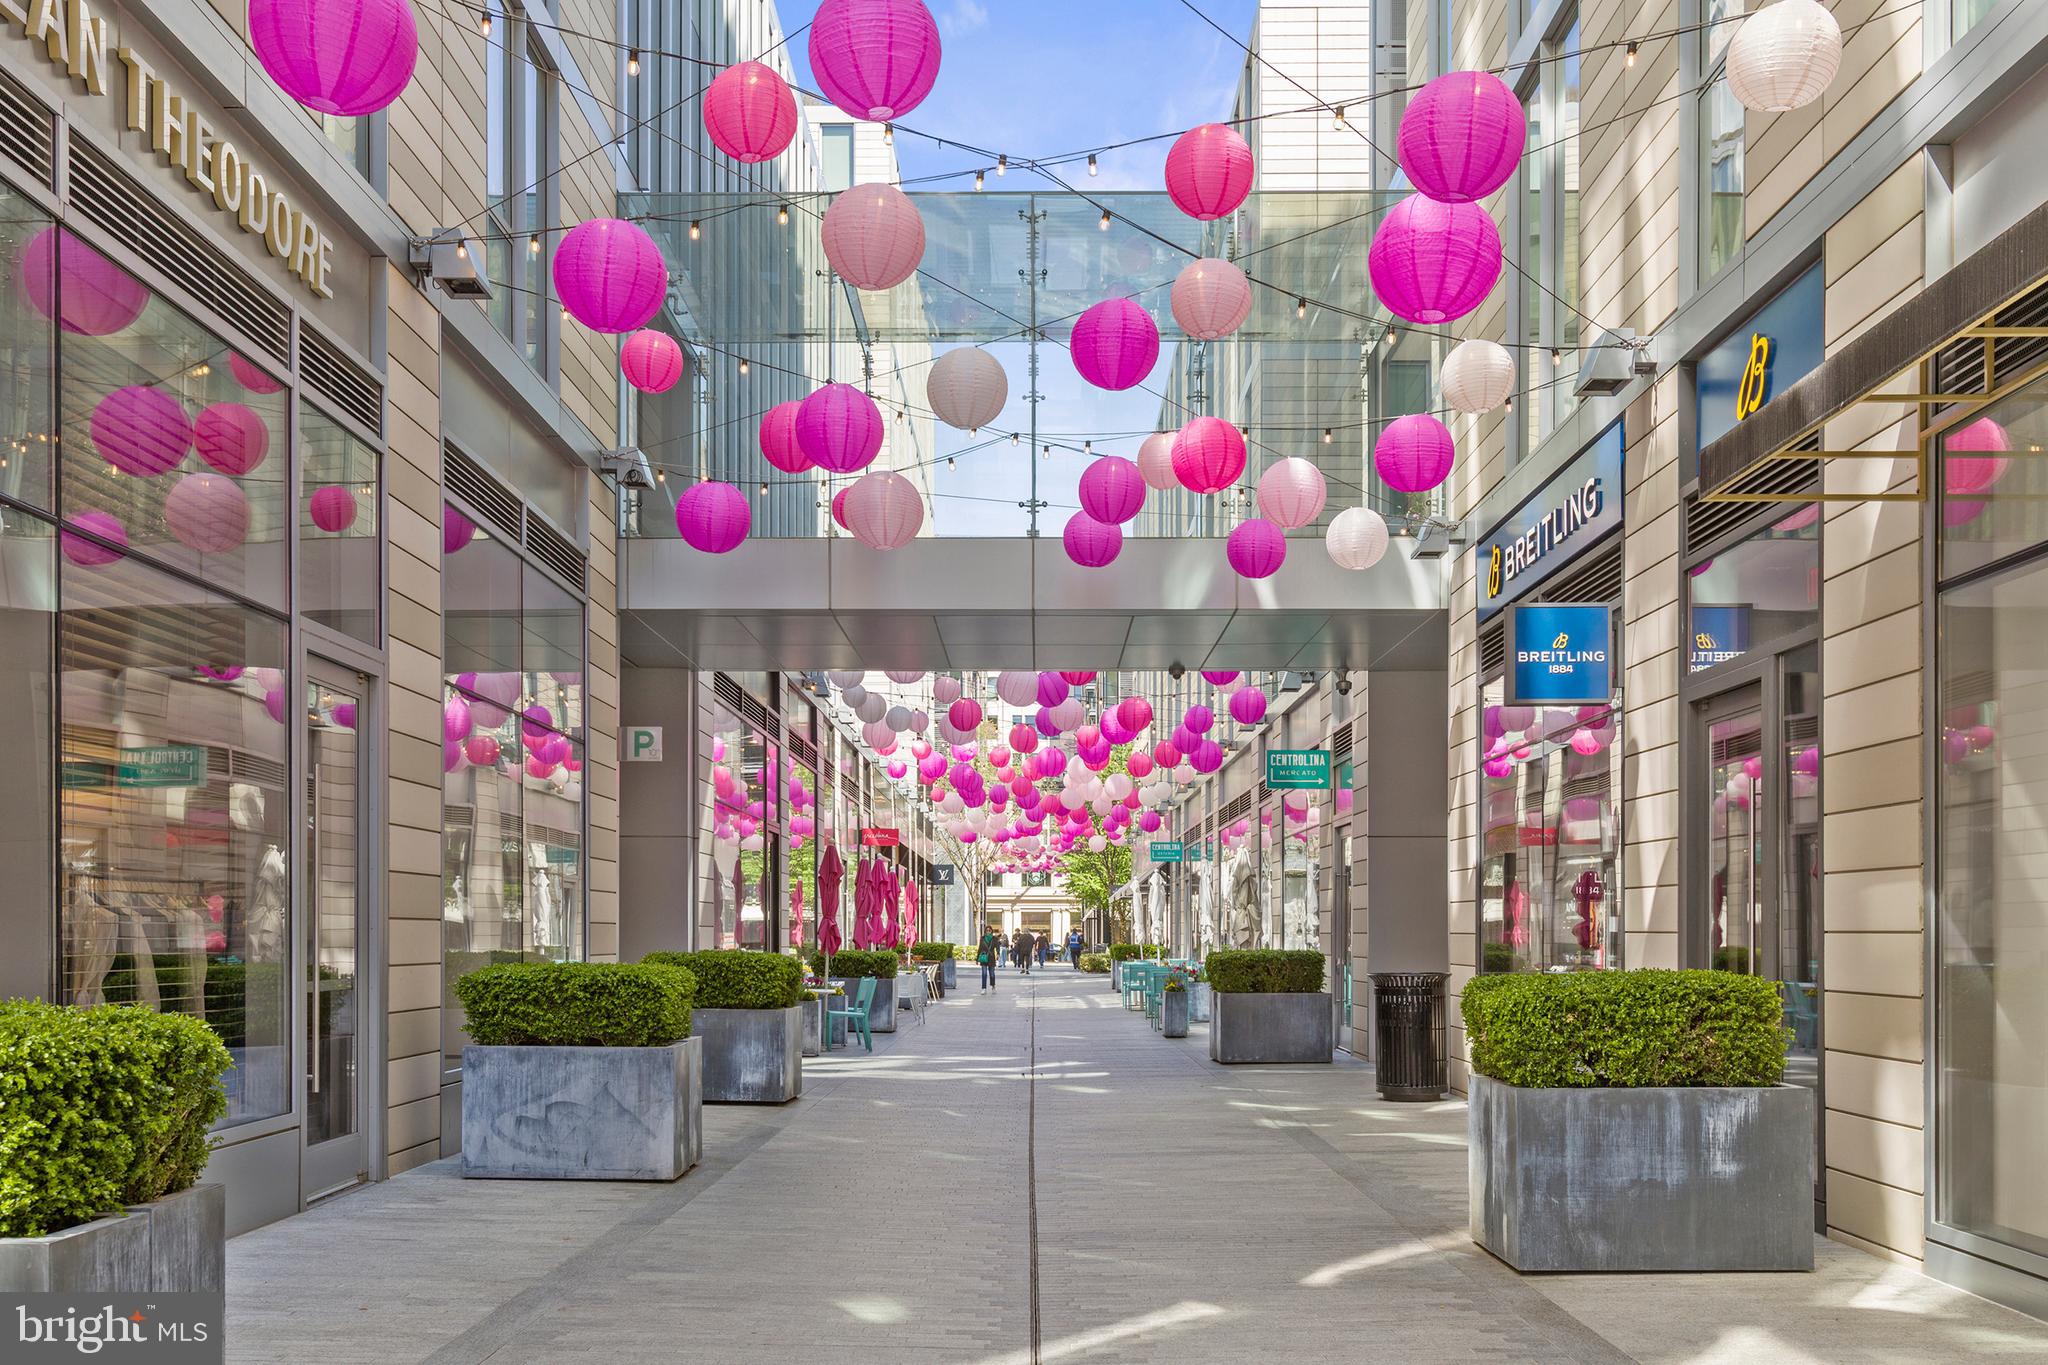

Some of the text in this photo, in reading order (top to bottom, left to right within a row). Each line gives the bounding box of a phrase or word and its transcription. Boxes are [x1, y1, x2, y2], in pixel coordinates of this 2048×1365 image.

[0, 0, 335, 300] AN THEODORE
[1504, 477, 1598, 582] BREITLING
[1517, 650, 1605, 663] BREITLING
[1548, 665, 1573, 674] 1884
[633, 730, 655, 758] P
[1270, 754, 1326, 766] CENTROLINA
